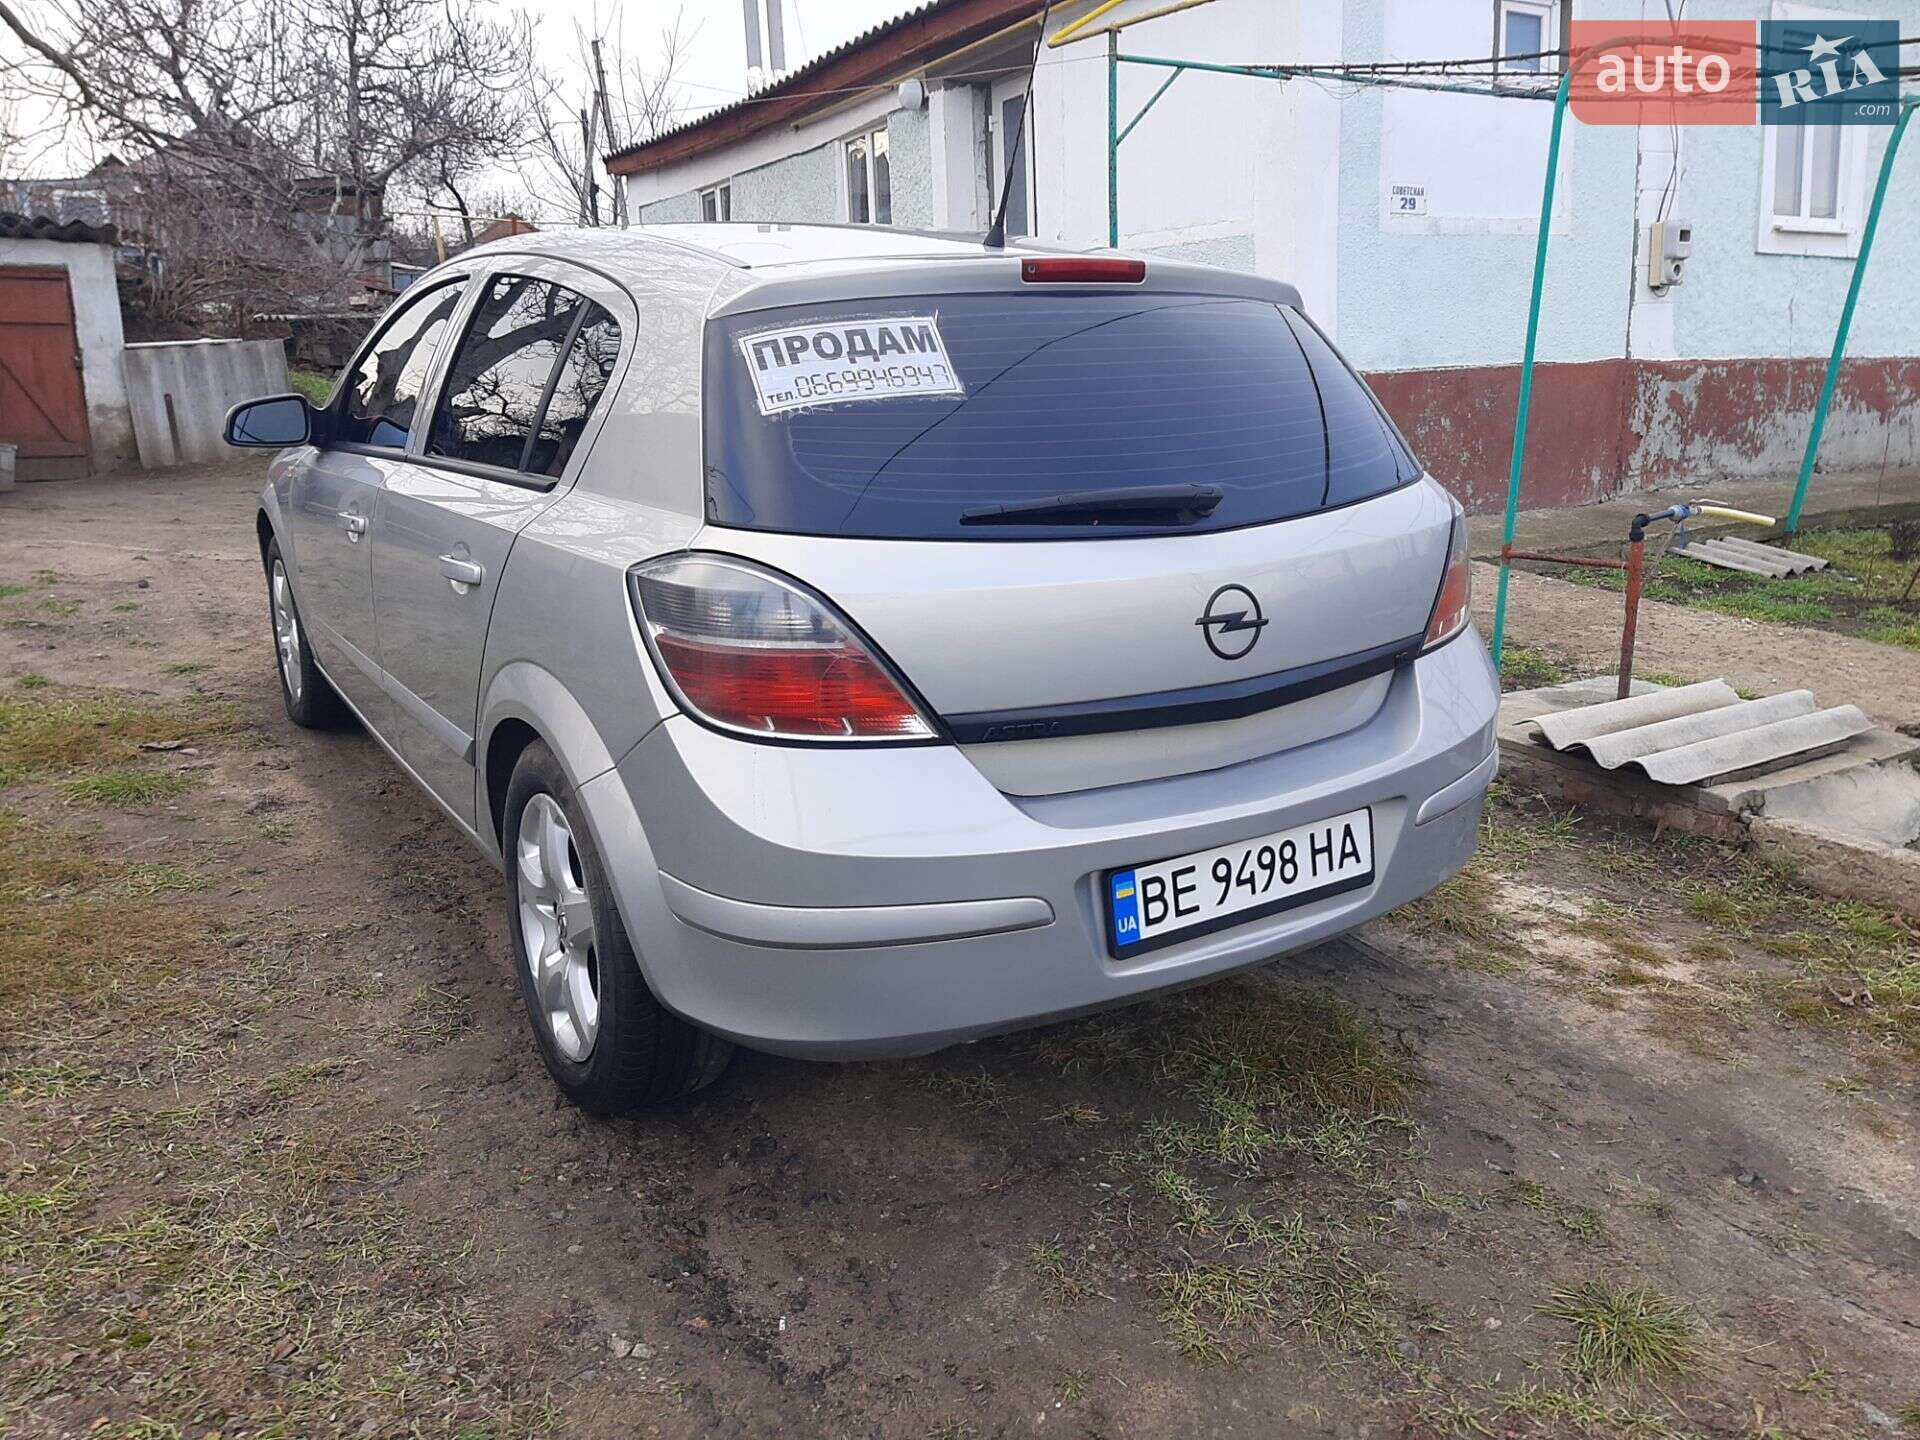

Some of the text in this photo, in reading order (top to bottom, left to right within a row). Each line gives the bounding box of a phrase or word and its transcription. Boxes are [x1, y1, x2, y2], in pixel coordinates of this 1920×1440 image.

[1400, 197, 1416, 210] 29
[751, 325, 938, 371] ПРОДАМ
[1141, 823, 1361, 927] BE 9498 HA
[1117, 918, 1138, 933] UA
